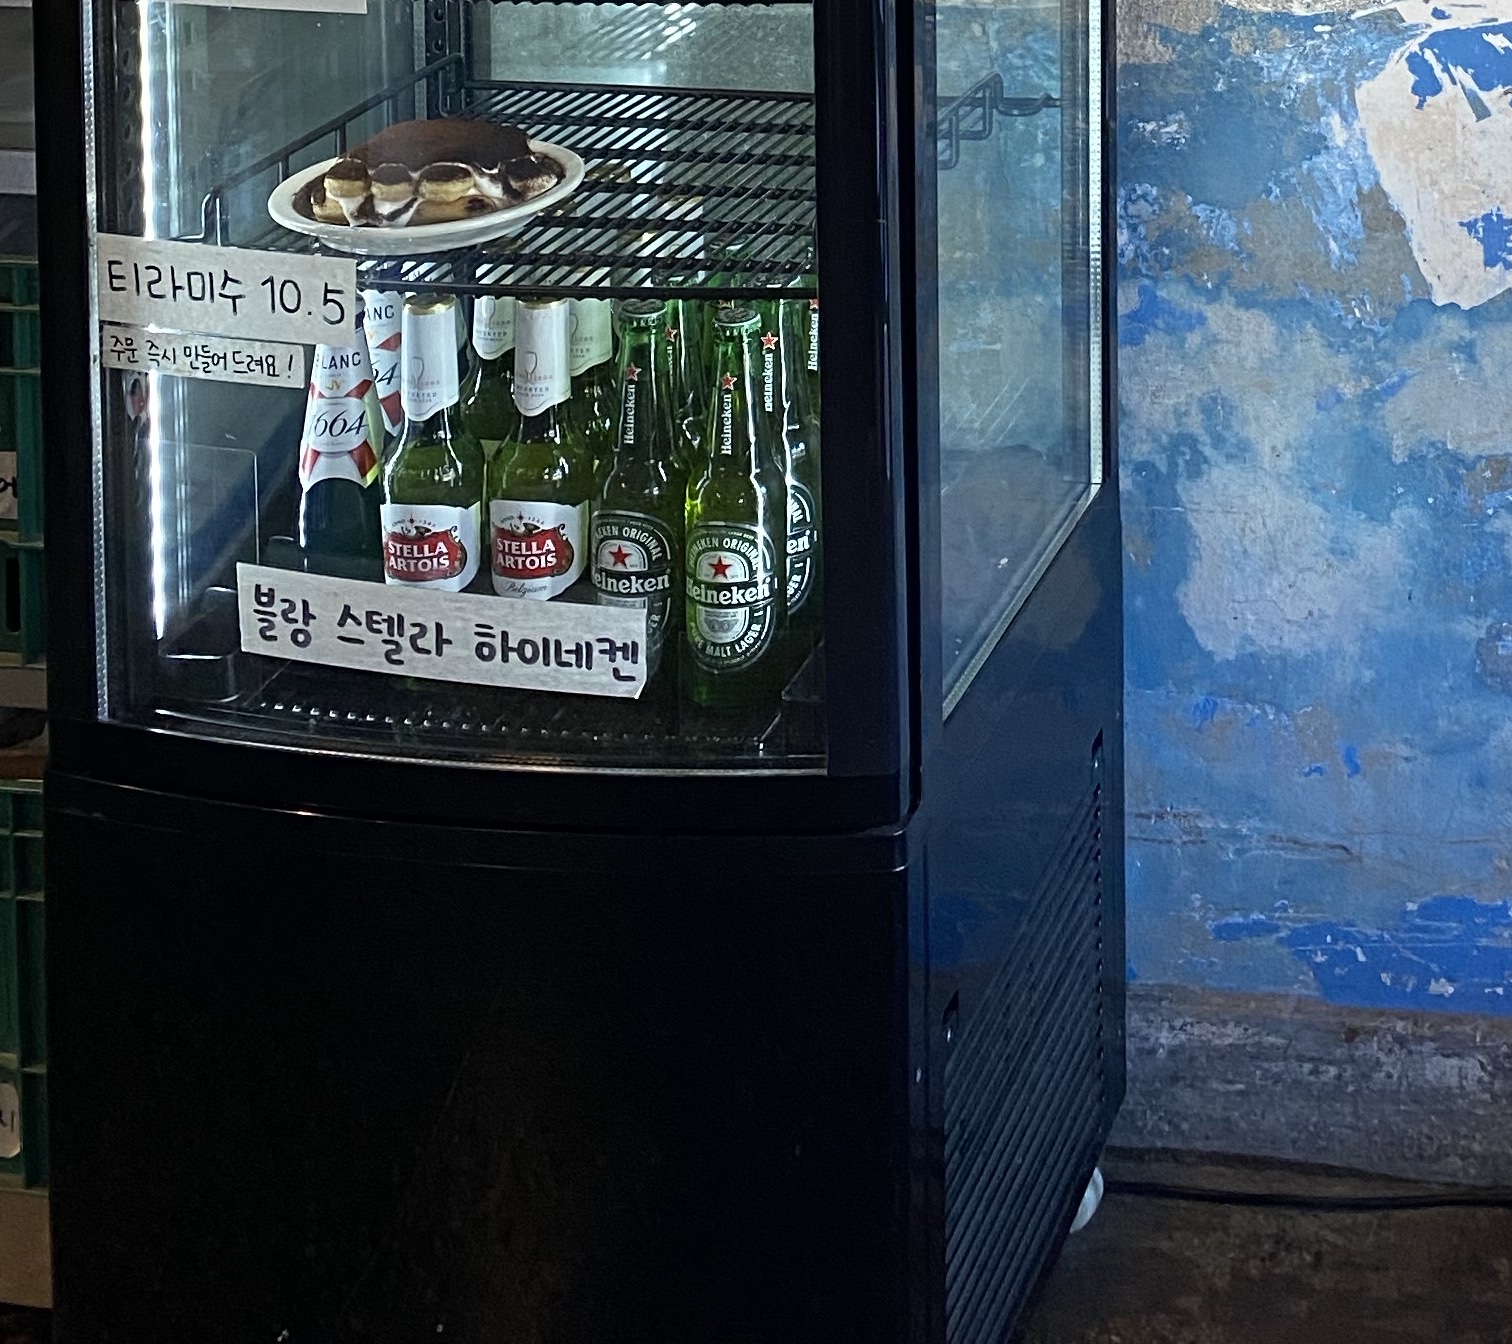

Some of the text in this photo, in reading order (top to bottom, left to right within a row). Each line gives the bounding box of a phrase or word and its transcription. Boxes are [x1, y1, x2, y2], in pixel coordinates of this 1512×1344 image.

[107, 259, 346, 326] 티라미수 10.5
[110, 335, 139, 364] 주문
[146, 339, 177, 366] 즉시
[388, 541, 449, 558] STELLA
[497, 538, 557, 555] STELLA
[389, 554, 450, 573] ARTOIS
[497, 553, 558, 570] ARTOIS
[594, 571, 670, 594] eineken
[253, 583, 315, 648] 블랑
[336, 602, 453, 665] 스텔라
[474, 624, 641, 683] 하이네켄
